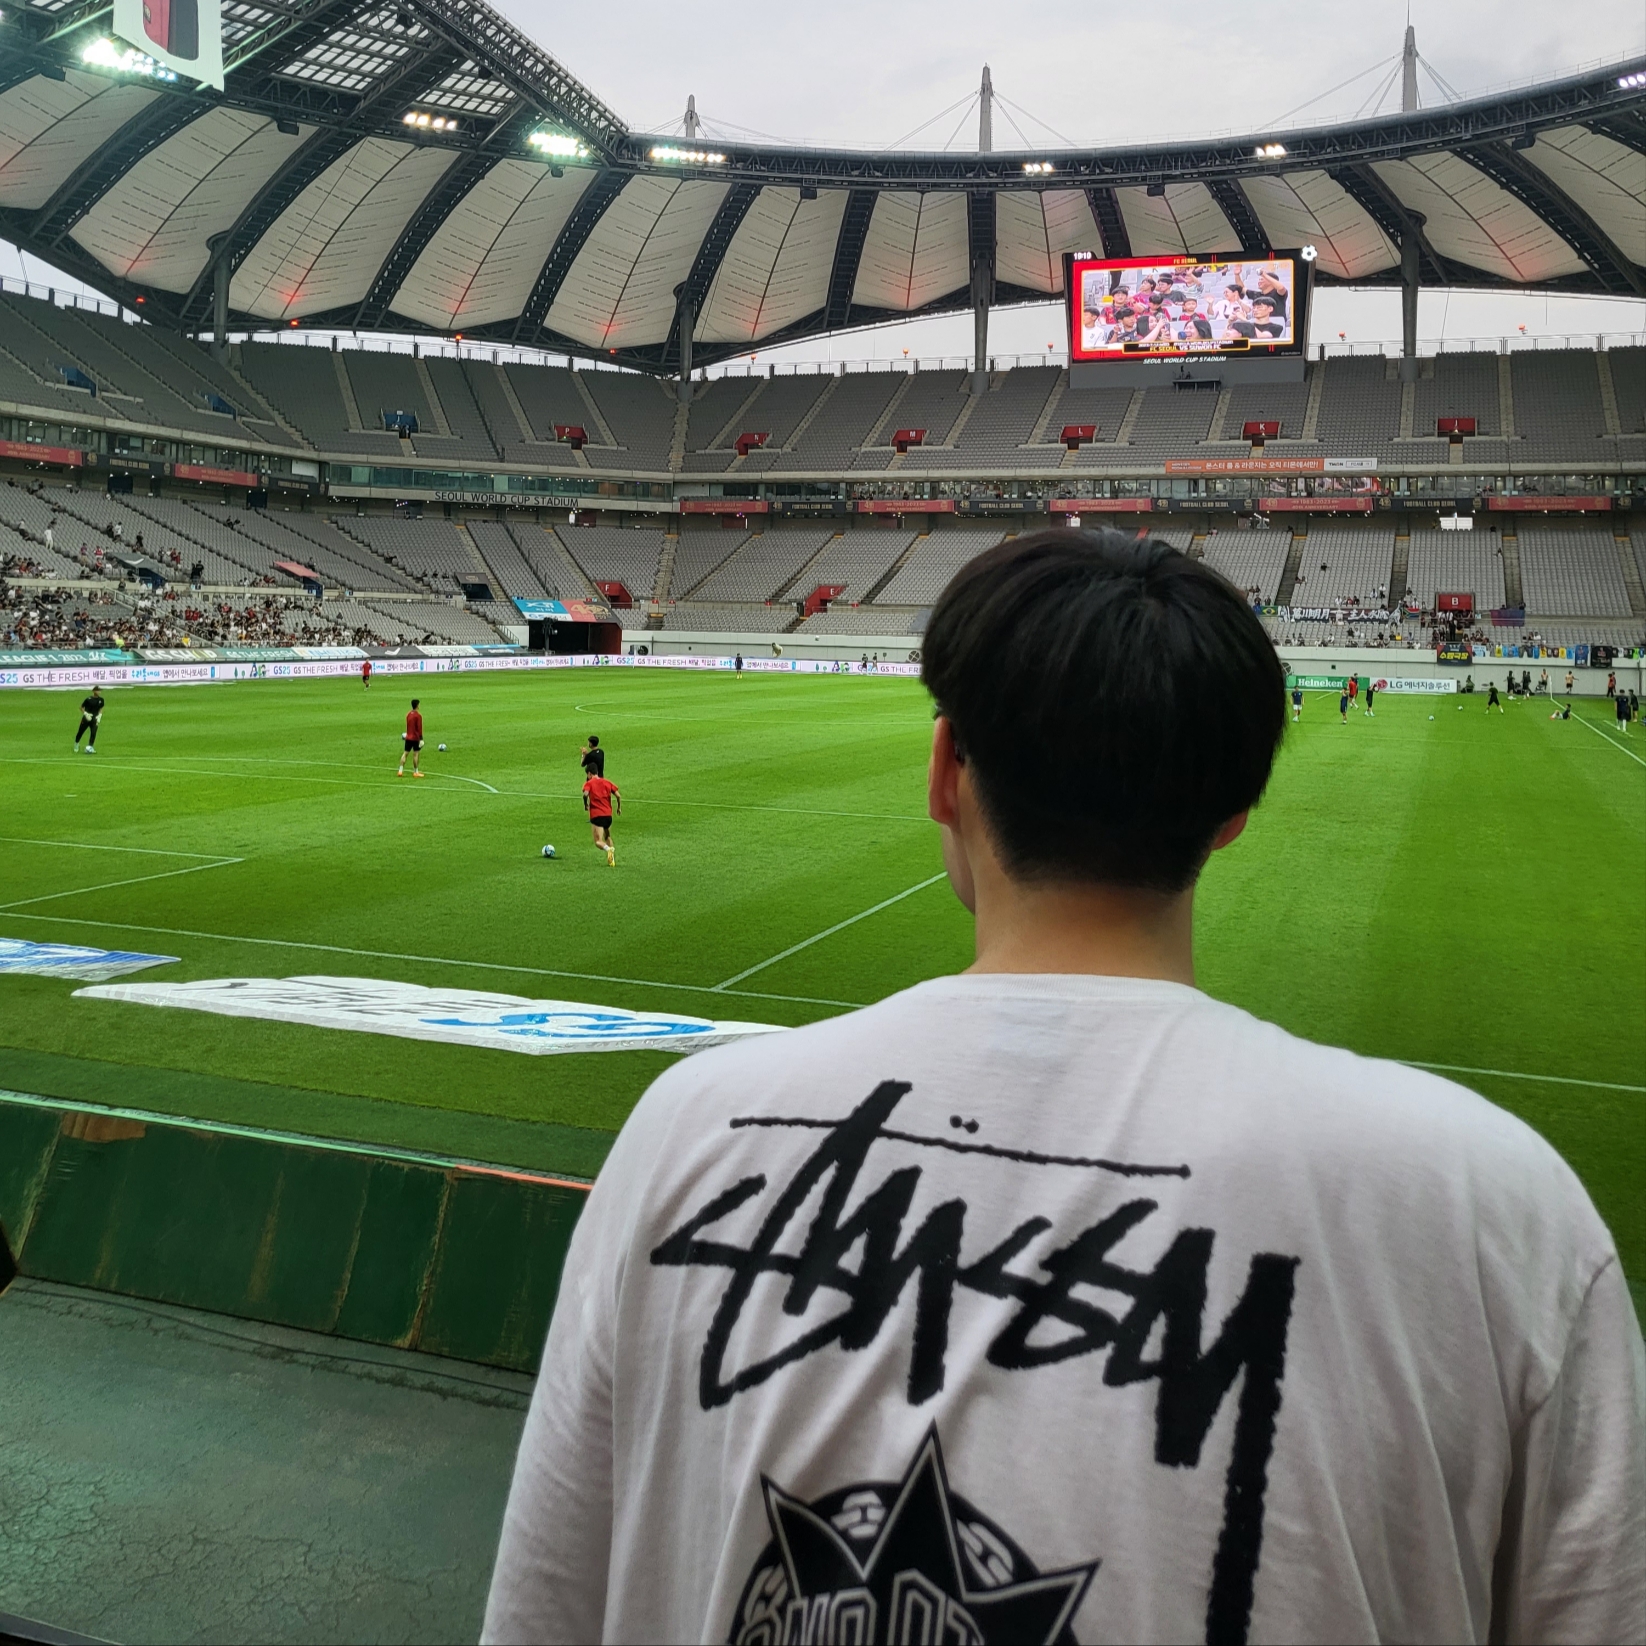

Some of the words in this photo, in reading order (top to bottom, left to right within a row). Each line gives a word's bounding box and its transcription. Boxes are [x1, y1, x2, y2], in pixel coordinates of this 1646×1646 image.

[435, 492, 467, 501] SEOUL
[471, 493, 507, 504] WORLD
[511, 495, 530, 505] CUP
[534, 497, 579, 507] STADIUM
[1452, 597, 1458, 605] B
[146, 649, 173, 659] GS
[274, 666, 290, 674] GS25
[317, 665, 338, 674] FRESH
[0, 673, 18, 683] S25
[23, 674, 34, 683] GS
[37, 673, 56, 683] THE
[59, 672, 89, 682] FRESH
[93, 670, 107, 680] 배달,
[109, 669, 127, 679] 픽업을
[163, 669, 180, 678] 앱에서
[181, 668, 208, 678] 만나보세요
[1298, 678, 1344, 687] Heineken
[1404, 681, 1450, 690] 에너지솔루션
